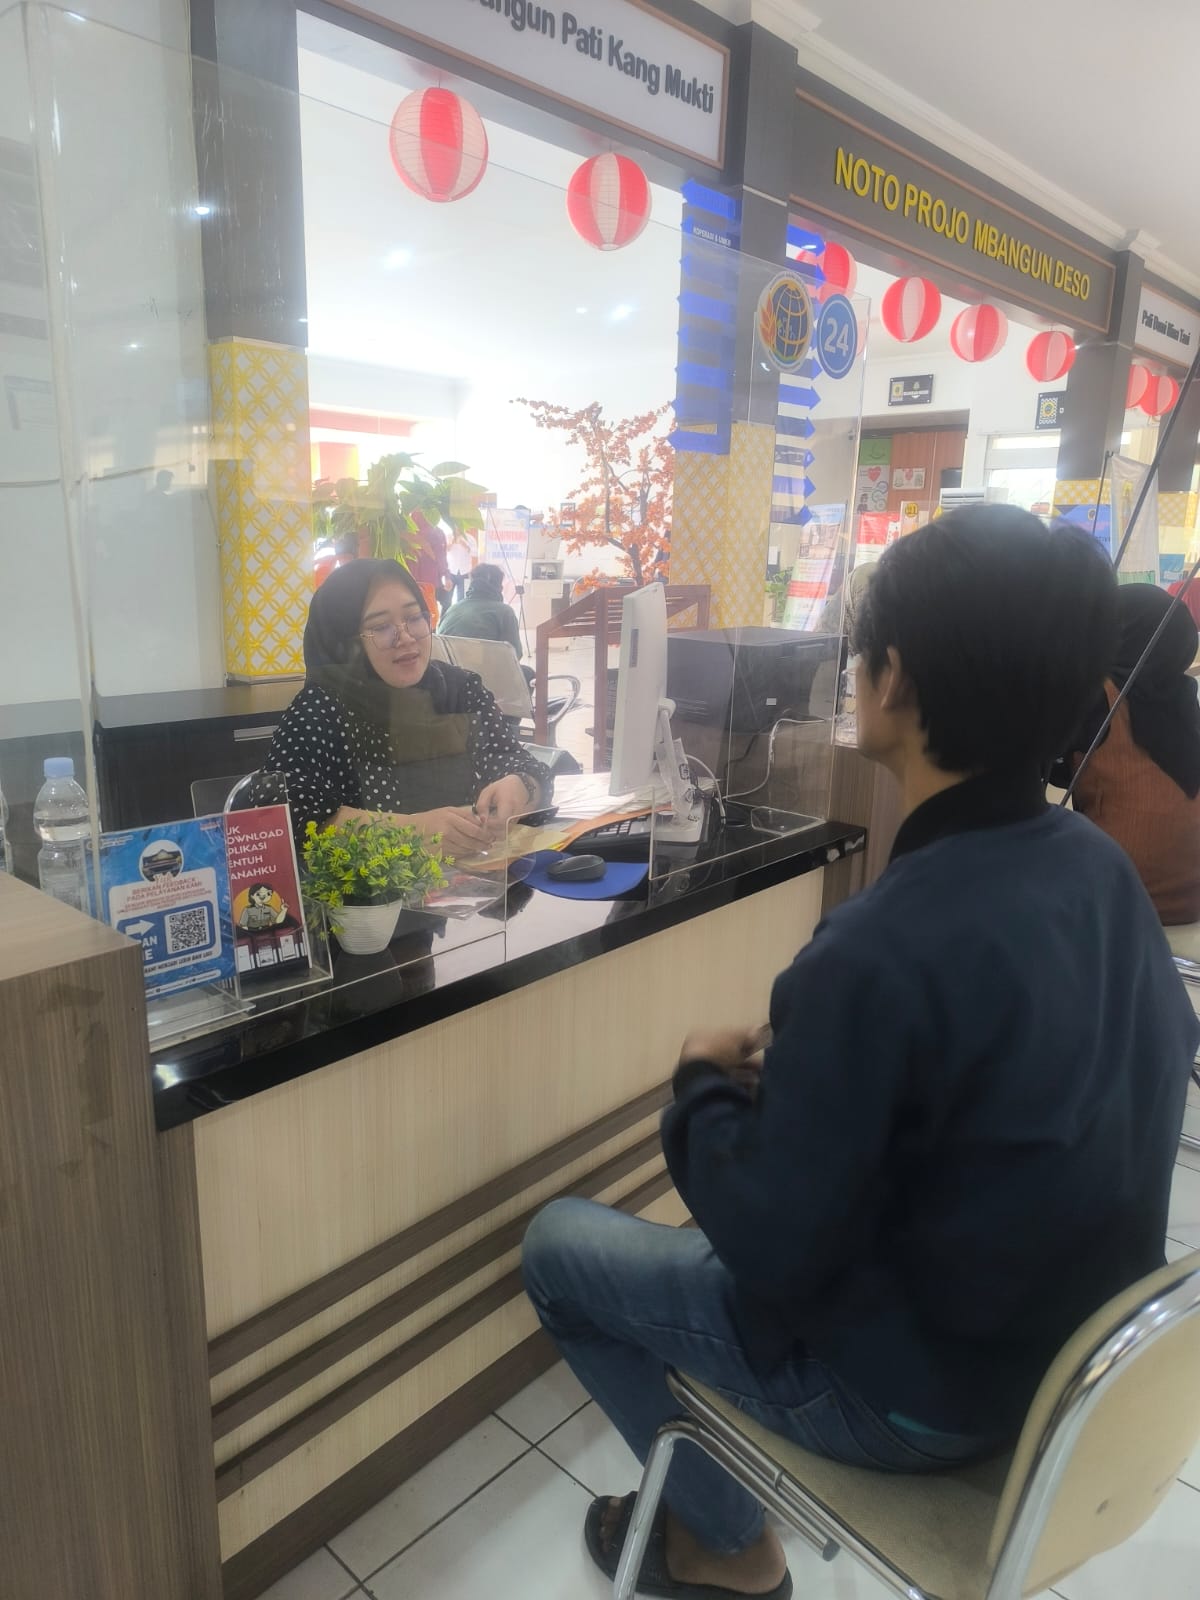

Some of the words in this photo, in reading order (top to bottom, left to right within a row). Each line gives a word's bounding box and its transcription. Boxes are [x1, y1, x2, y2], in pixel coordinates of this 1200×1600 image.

[561, 12, 603, 61] Pati
[608, 34, 661, 96] Kang
[665, 64, 715, 114] Mukti
[835, 146, 901, 212] NOTO
[904, 183, 970, 244] PROJO
[973, 219, 1054, 285] MBANGUN
[1053, 260, 1091, 301] DESO
[824, 317, 849, 357] 24
